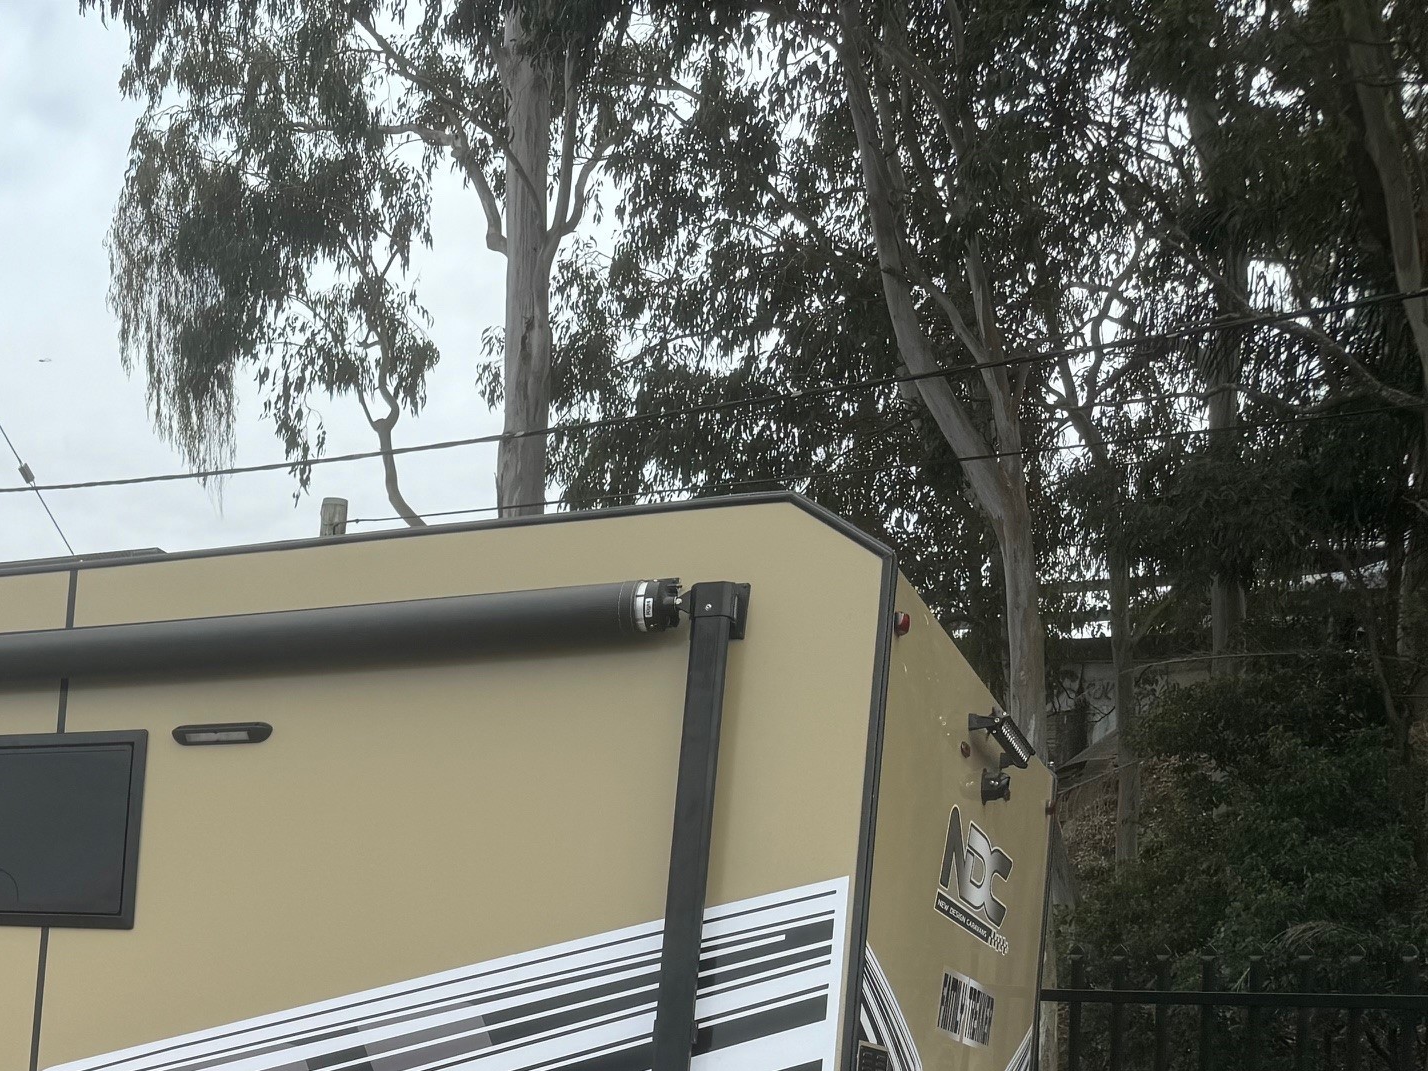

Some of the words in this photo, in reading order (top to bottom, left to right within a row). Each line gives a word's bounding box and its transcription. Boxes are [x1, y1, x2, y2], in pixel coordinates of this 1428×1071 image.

[939, 804, 1013, 929] NDC
[937, 899, 949, 911] NEW
[949, 907, 966, 923] DESIGN
